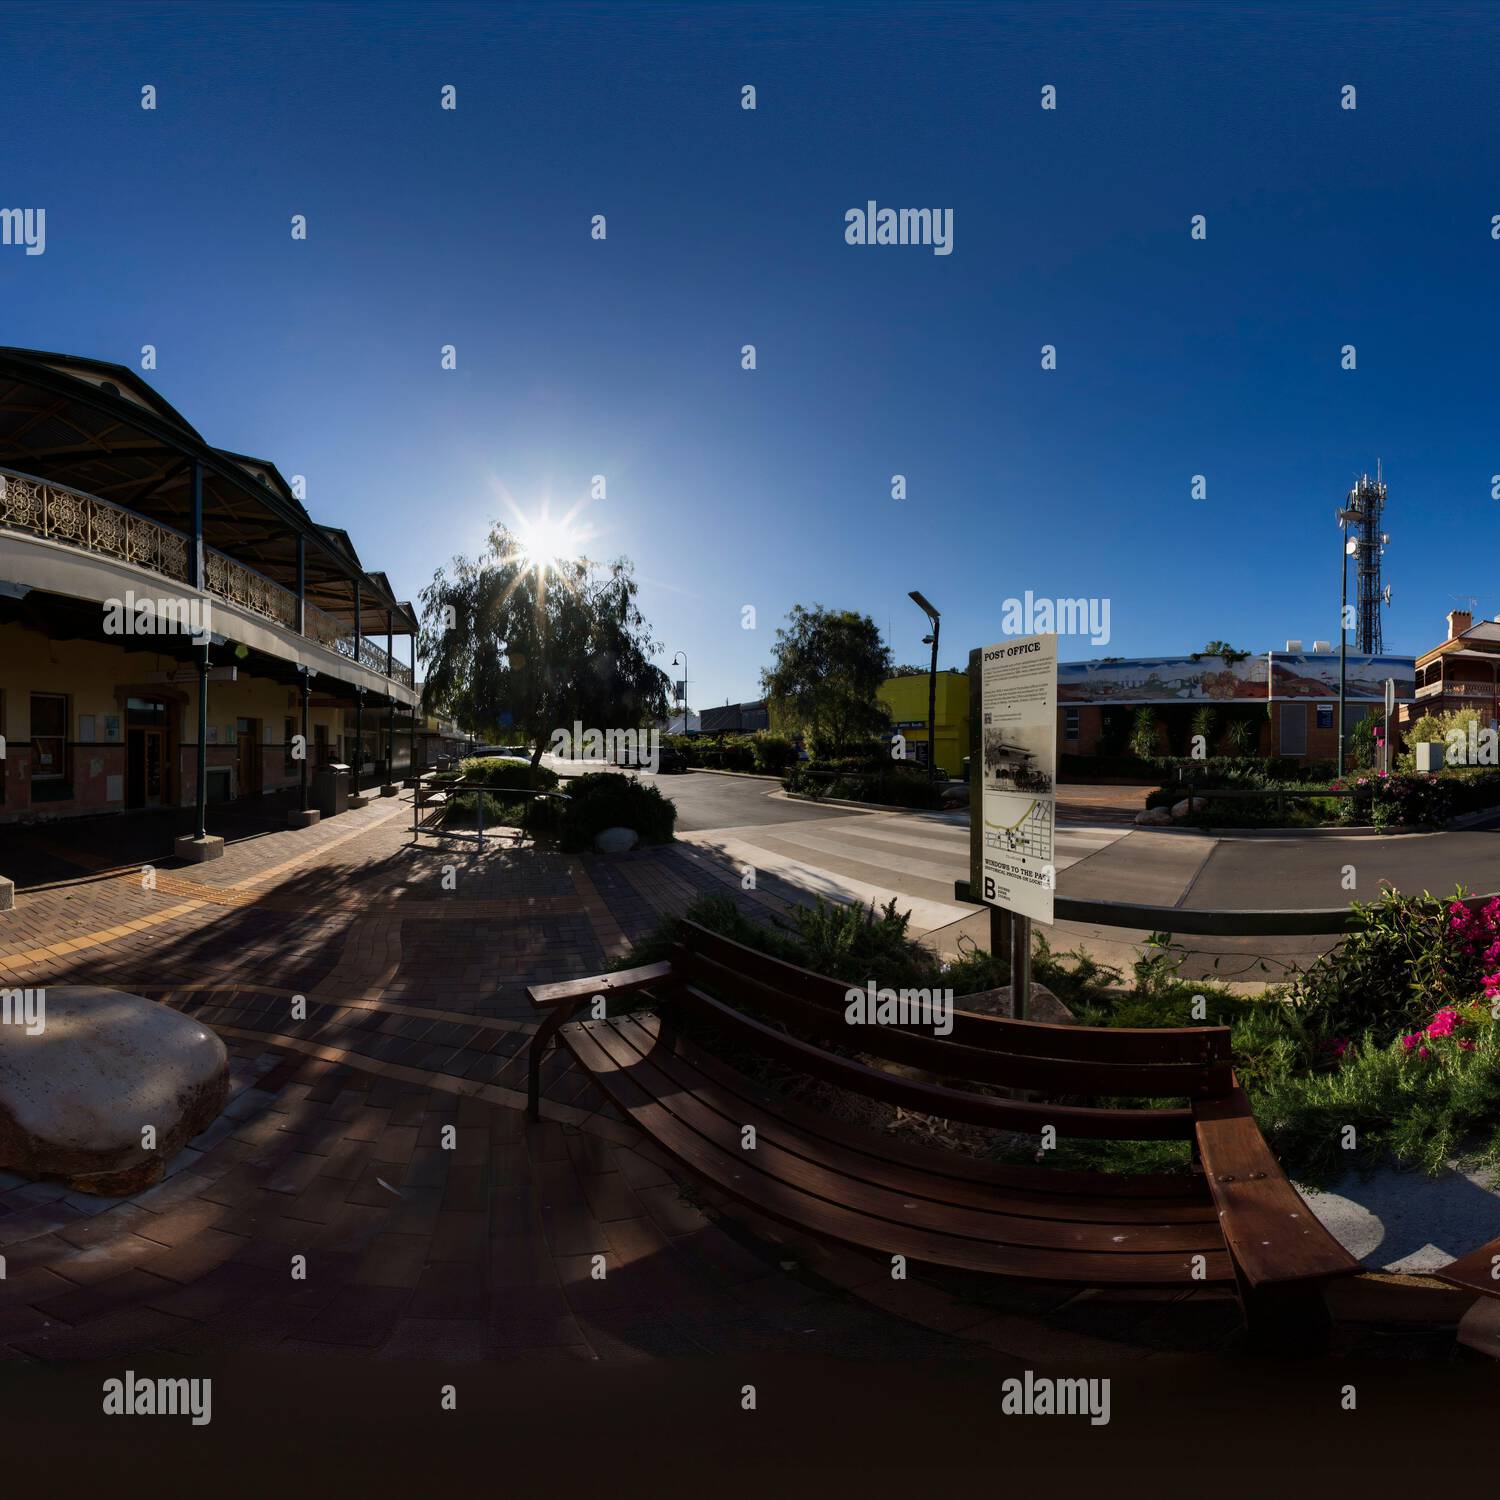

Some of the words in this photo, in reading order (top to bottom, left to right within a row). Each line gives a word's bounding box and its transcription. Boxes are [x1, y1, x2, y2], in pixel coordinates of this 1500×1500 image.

[984, 650, 1005, 661] POST
[1007, 642, 1041, 656] OFFICE
[985, 859, 1010, 870] WINDOWS
[1021, 869, 1033, 877] THE
[985, 876, 996, 899] B
